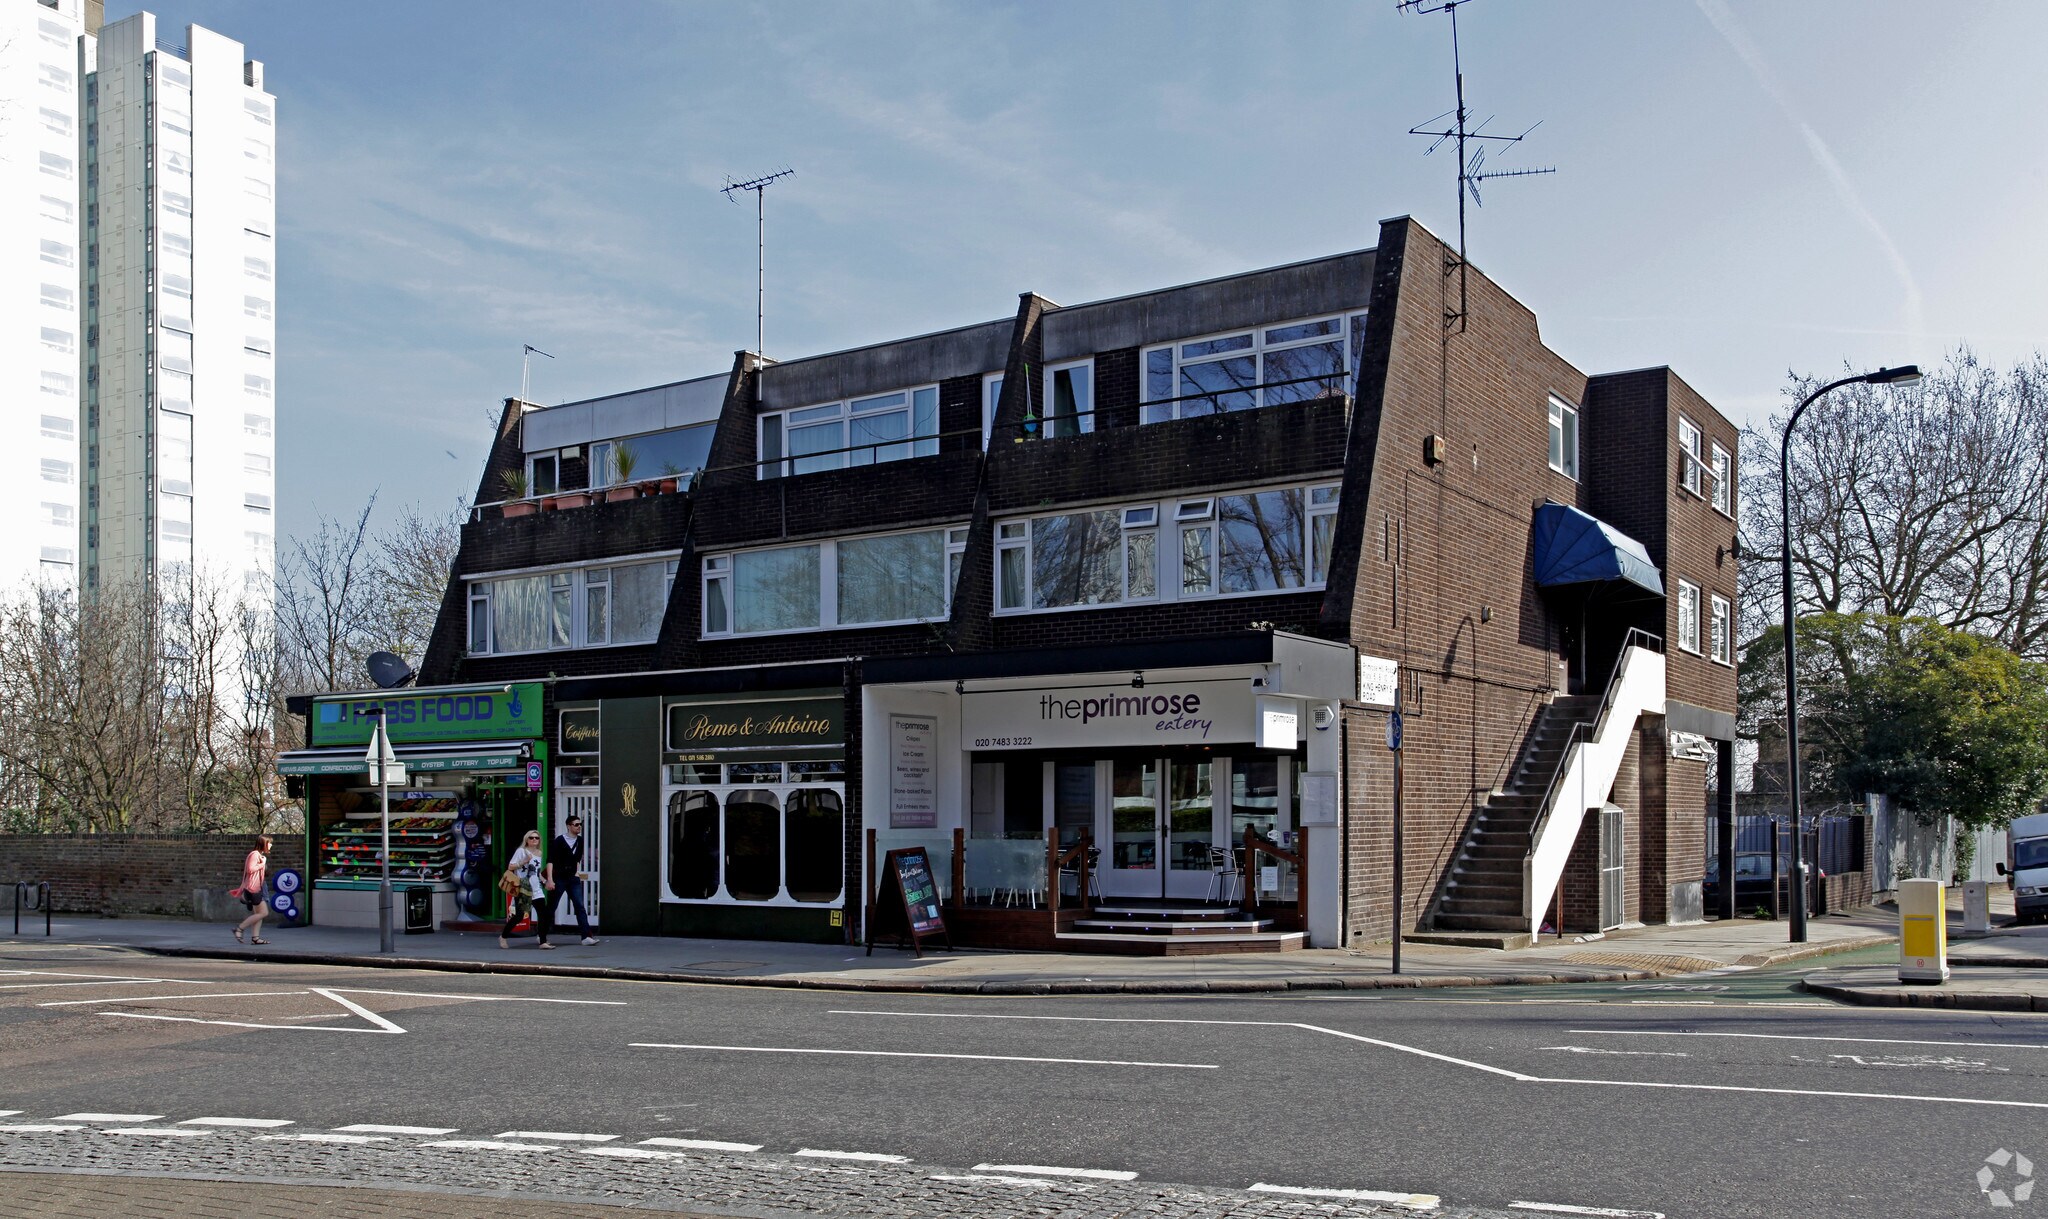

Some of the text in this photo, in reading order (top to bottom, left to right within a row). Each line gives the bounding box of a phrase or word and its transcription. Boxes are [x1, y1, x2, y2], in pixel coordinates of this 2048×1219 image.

[1362, 682, 1374, 691] KING
[1362, 692, 1376, 701] ROAD
[353, 695, 493, 725] FABS FOOD
[1040, 693, 1200, 724] theprimrose
[684, 713, 830, 741] Remo & Antoine
[1155, 712, 1212, 739] eatery
[975, 736, 1032, 747] 020 7483 3222
[452, 759, 480, 767] LOTTERY
[832, 911, 841, 925] H
